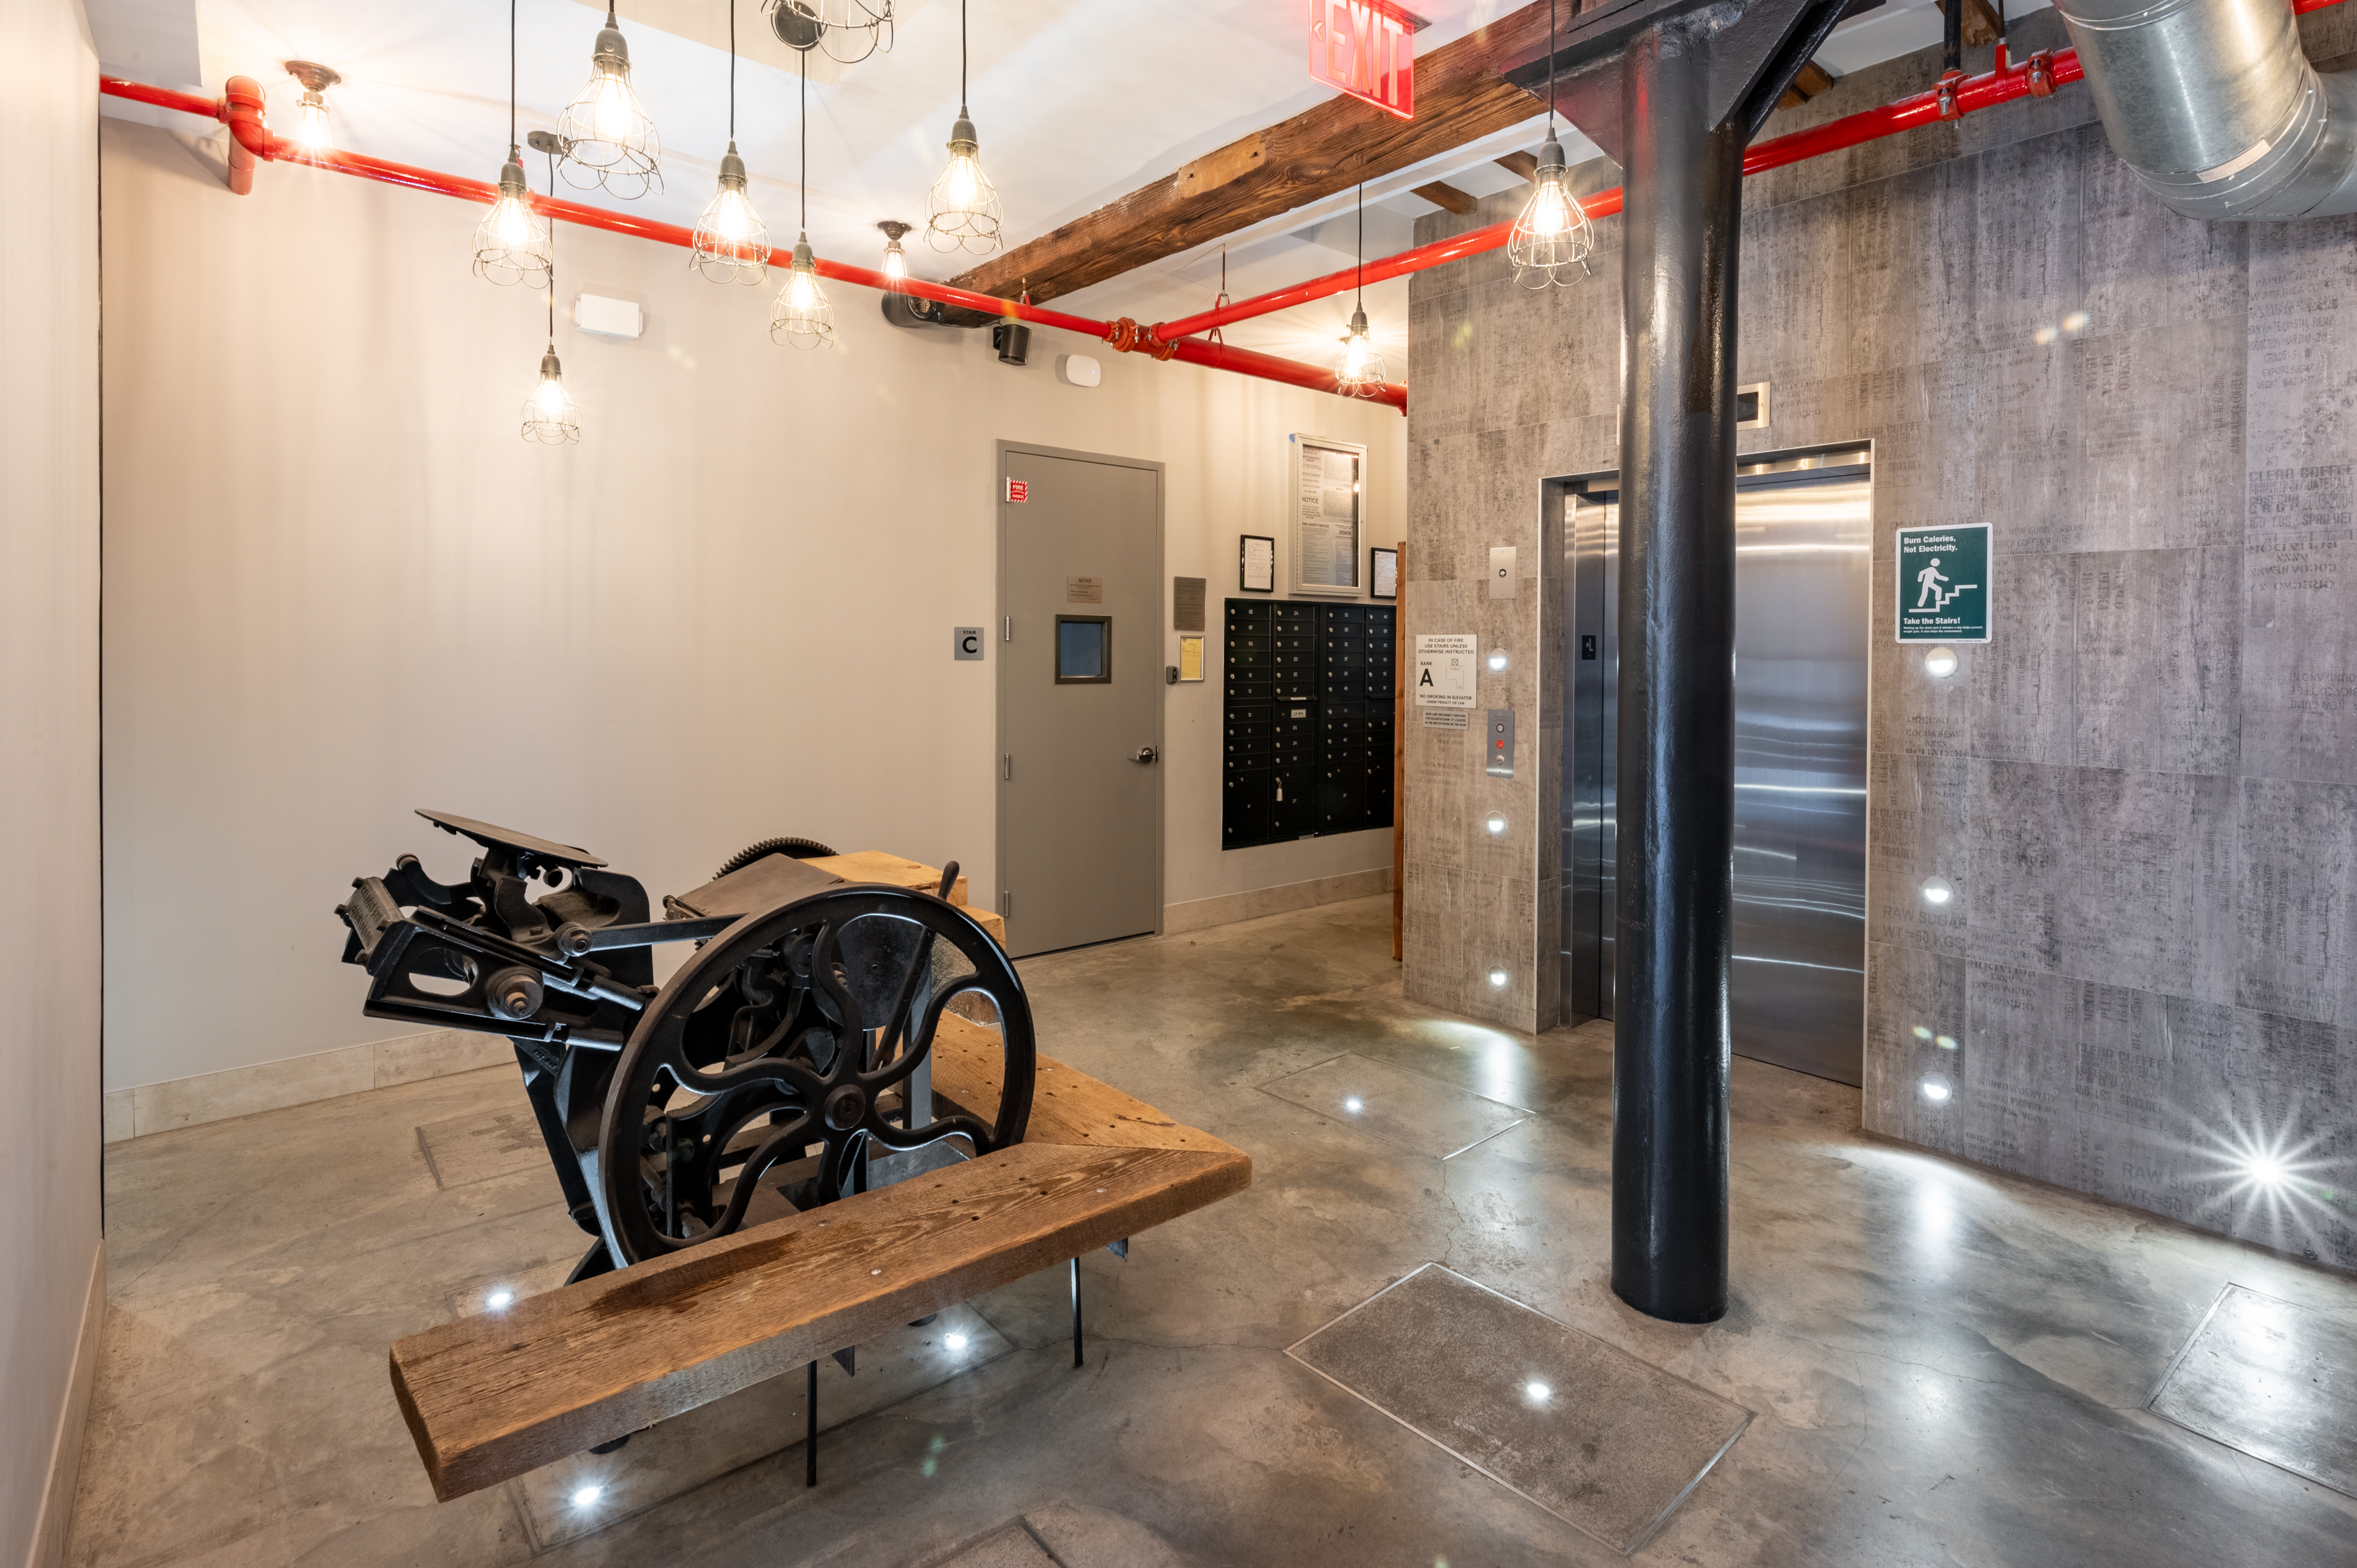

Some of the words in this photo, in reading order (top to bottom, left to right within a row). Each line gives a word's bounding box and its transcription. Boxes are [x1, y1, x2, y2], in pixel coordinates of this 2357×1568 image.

[1325, 0, 1403, 107] EXIT
[1918, 544, 1957, 553] Electricity.
[962, 636, 977, 653] C
[1419, 668, 1434, 687] A
